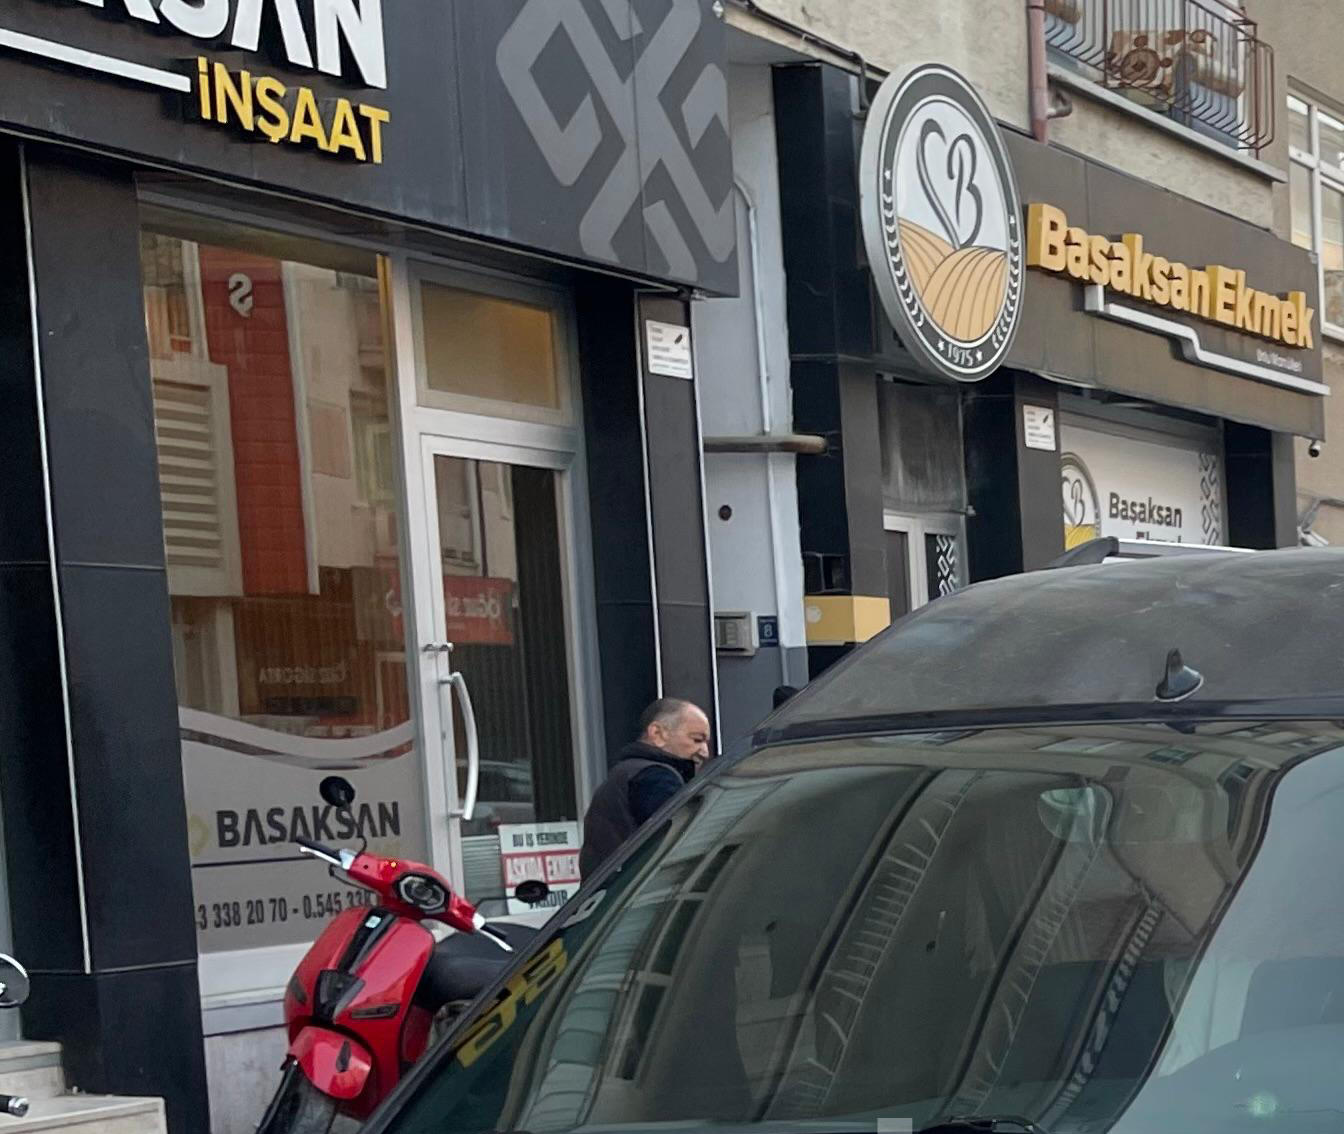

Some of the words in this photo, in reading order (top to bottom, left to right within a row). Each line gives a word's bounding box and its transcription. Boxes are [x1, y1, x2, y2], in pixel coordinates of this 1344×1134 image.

[198, 56, 390, 164] İNŞAAT
[947, 343, 973, 366] 1975
[213, 902, 242, 928] 338
[247, 899, 264, 924] 20
[270, 897, 287, 922] 70
